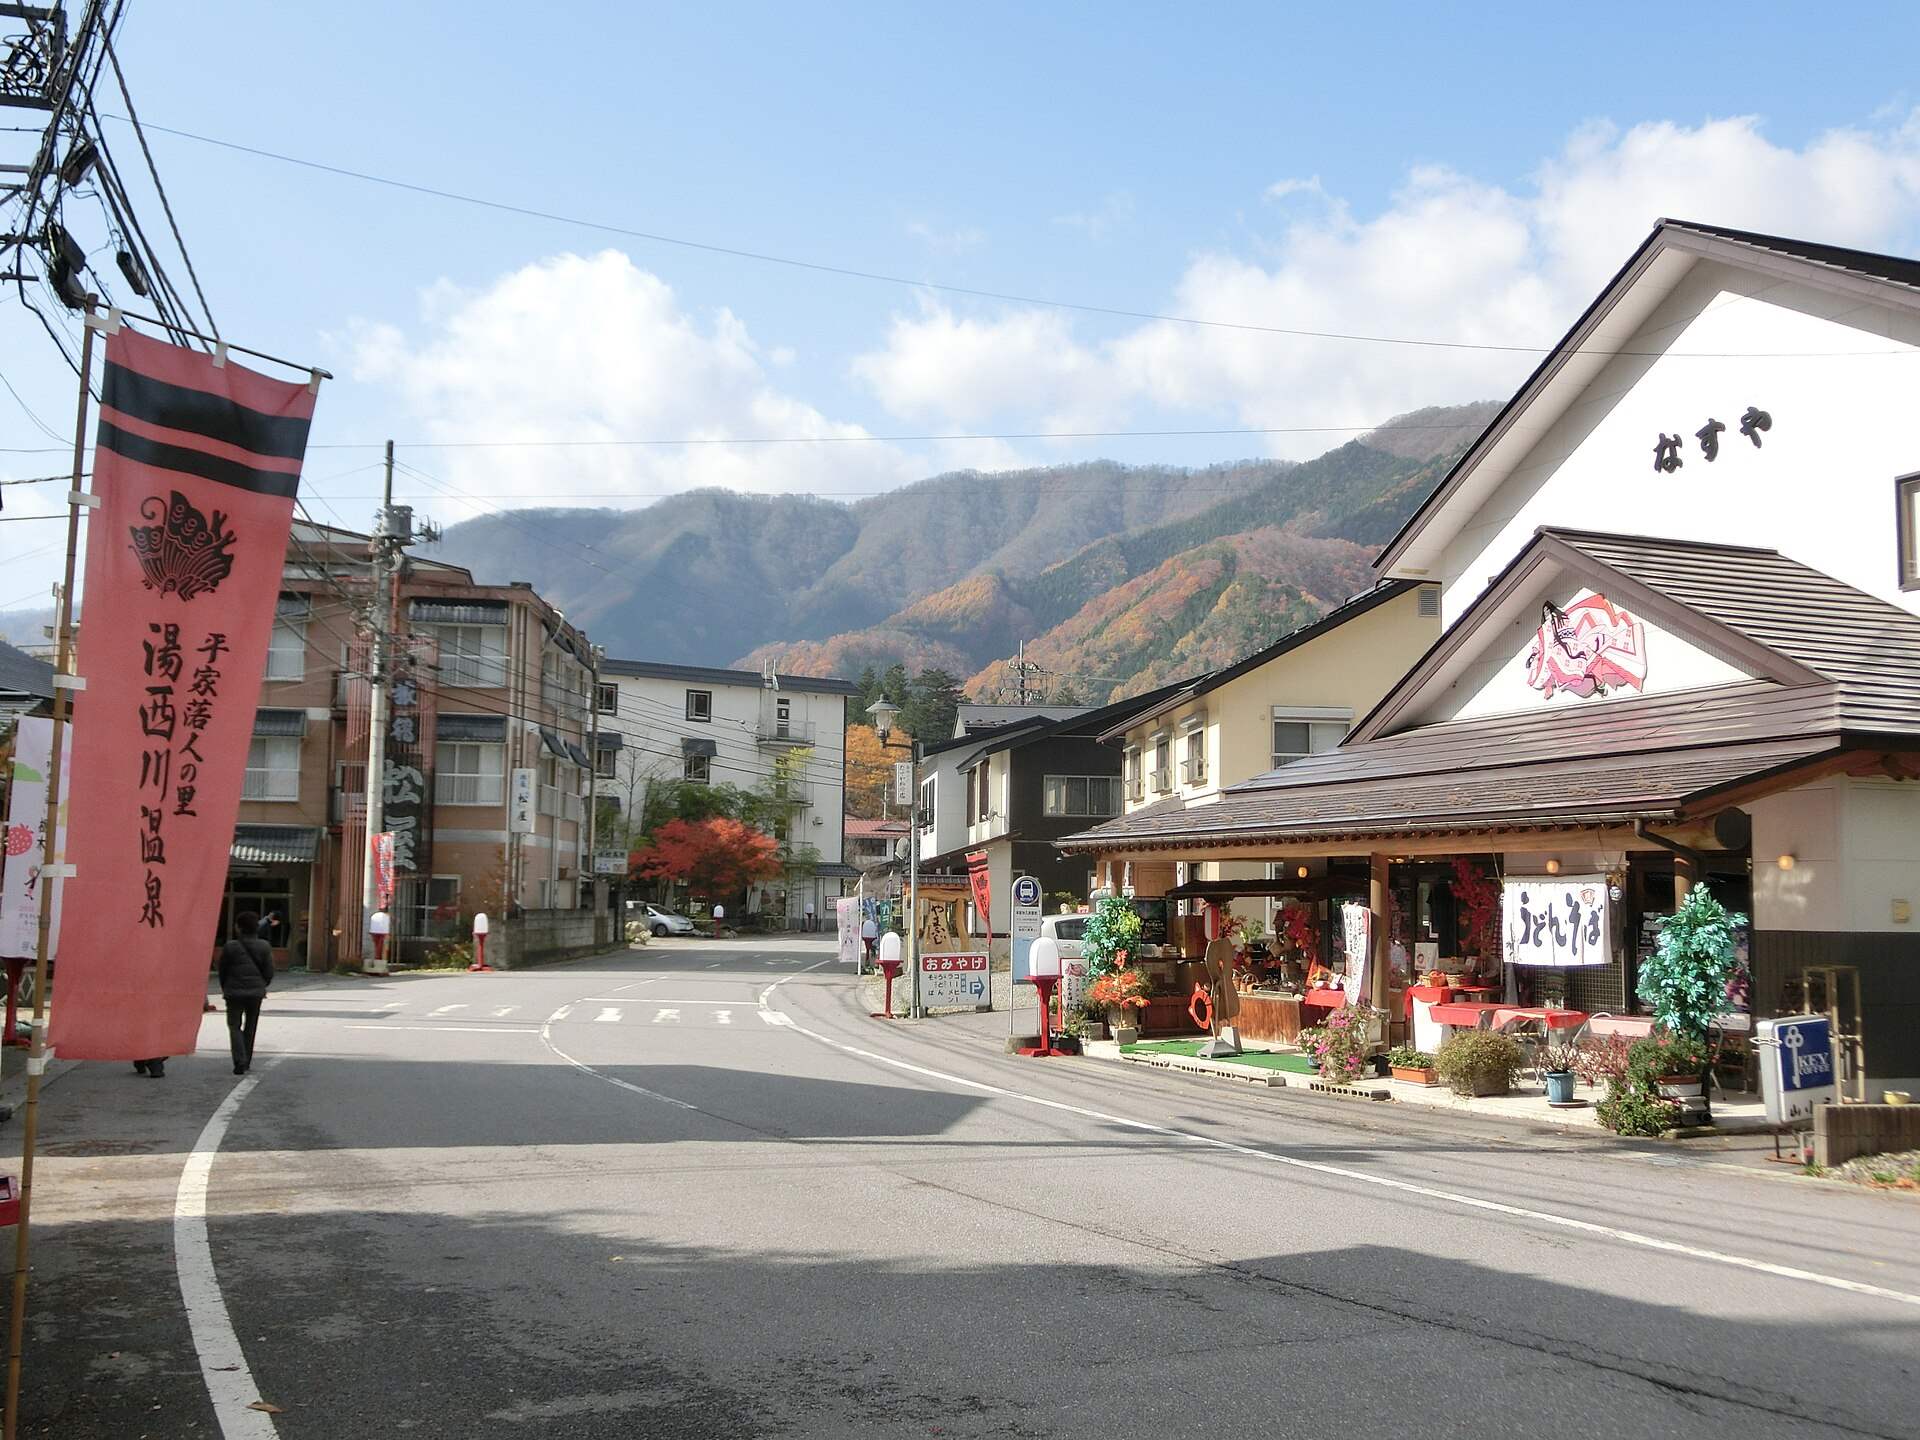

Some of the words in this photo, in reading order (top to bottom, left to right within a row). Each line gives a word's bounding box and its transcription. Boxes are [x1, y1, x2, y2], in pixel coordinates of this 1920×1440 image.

[1654, 406, 1774, 474] なすや
[137, 622, 183, 928] 湯西川温泉
[383, 759, 424, 870] 松屋
[926, 957, 984, 970] おみやげ
[1799, 1052, 1830, 1067] KEY
[1799, 1064, 1831, 1076] COFFEE
